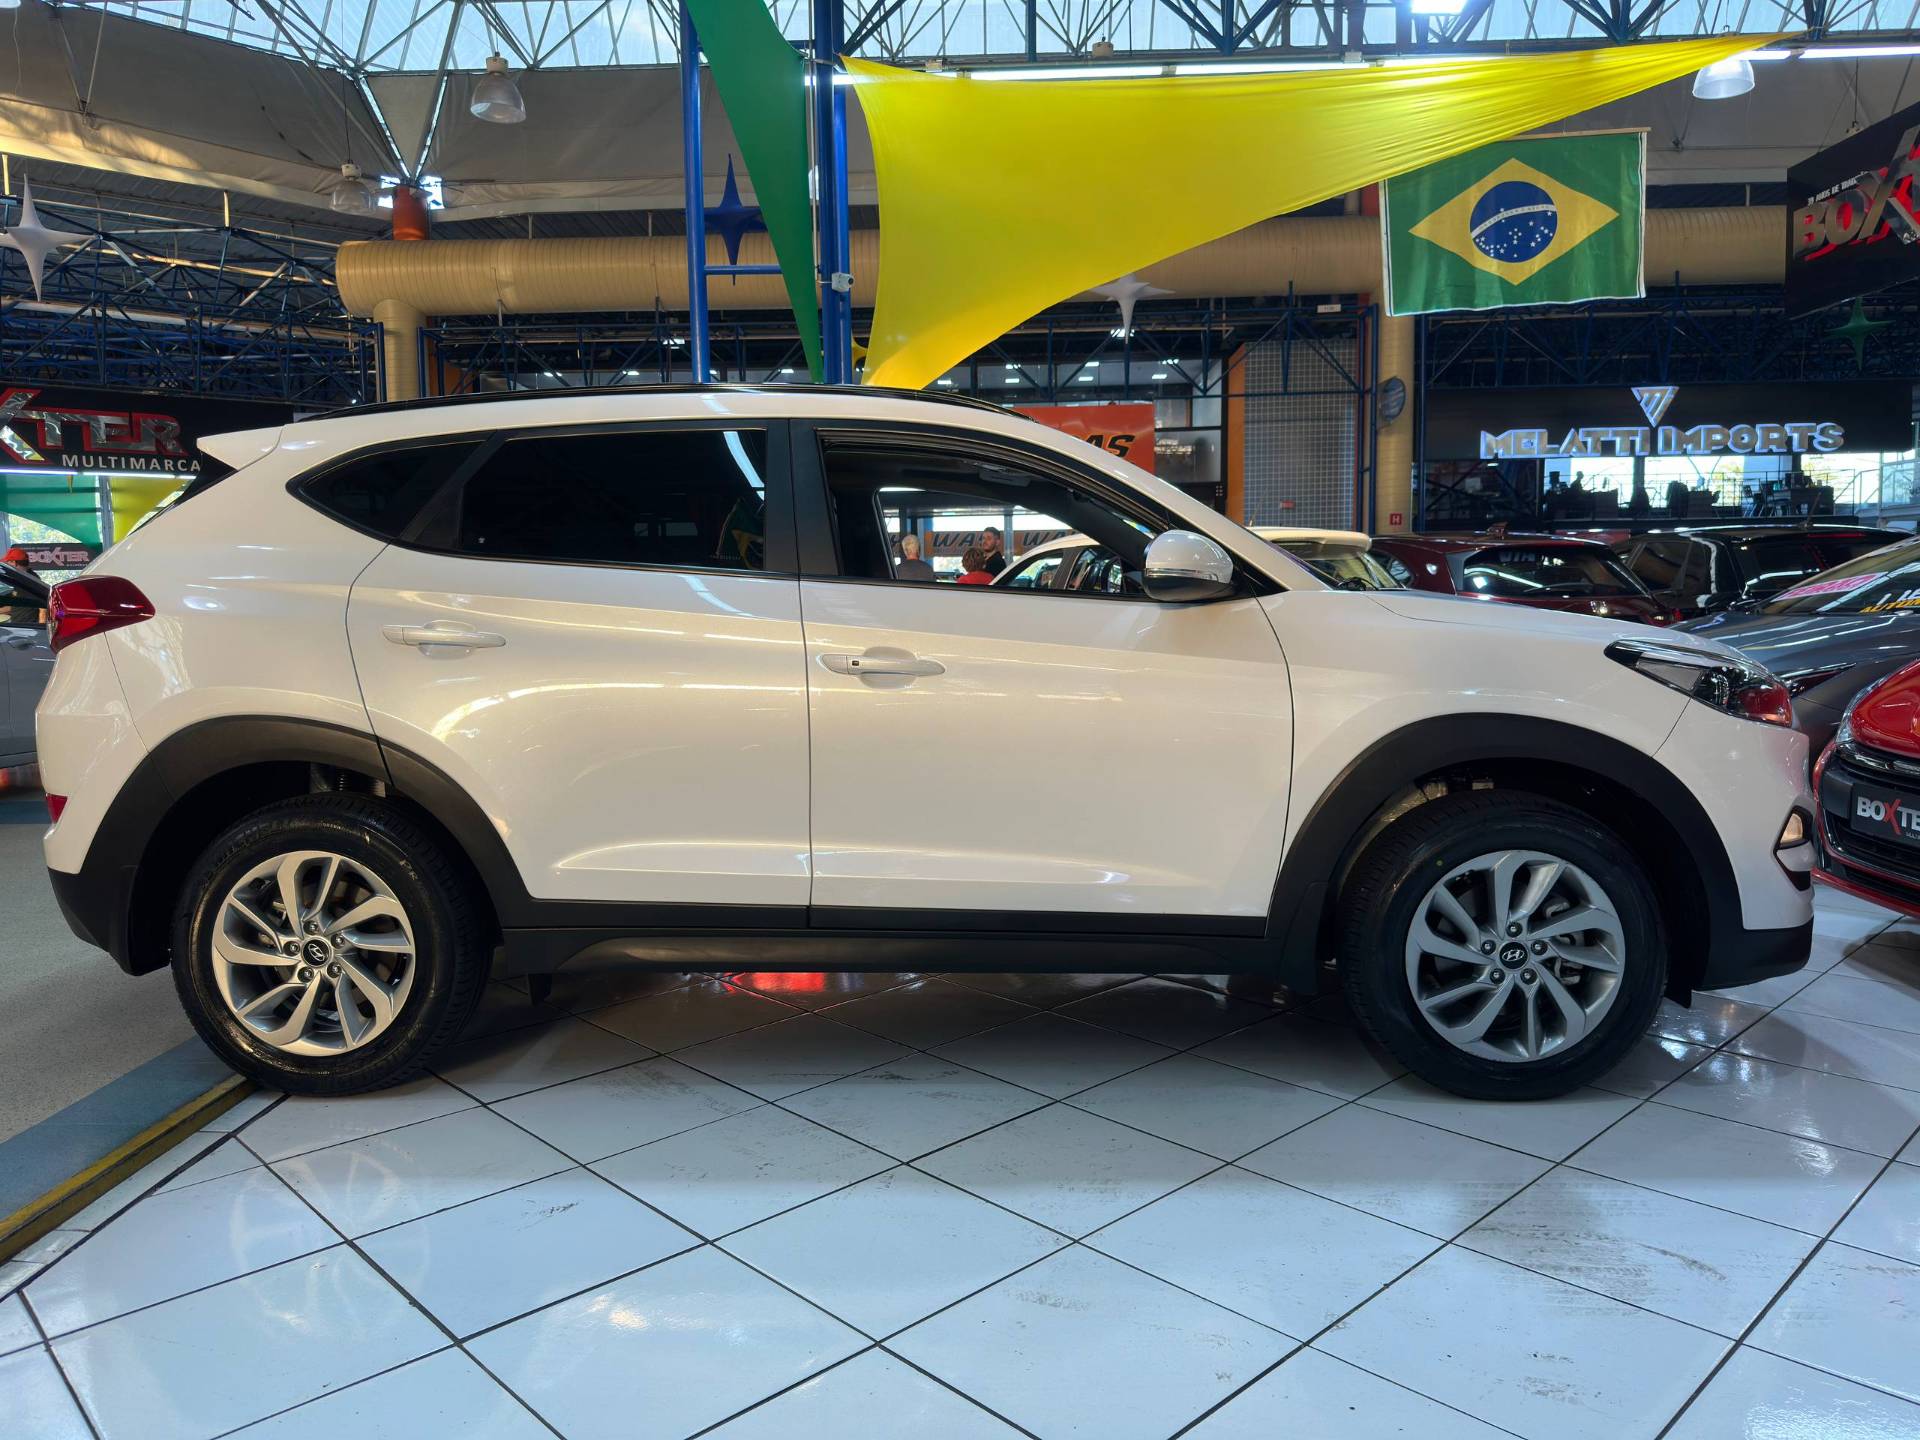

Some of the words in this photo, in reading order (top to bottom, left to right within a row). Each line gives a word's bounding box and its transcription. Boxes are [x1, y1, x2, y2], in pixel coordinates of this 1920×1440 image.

[1793, 125, 1920, 260] BOX
[1074, 434, 1136, 458] AS
[1480, 426, 1650, 459] MELATTI
[1658, 422, 1845, 455] IMPORTS
